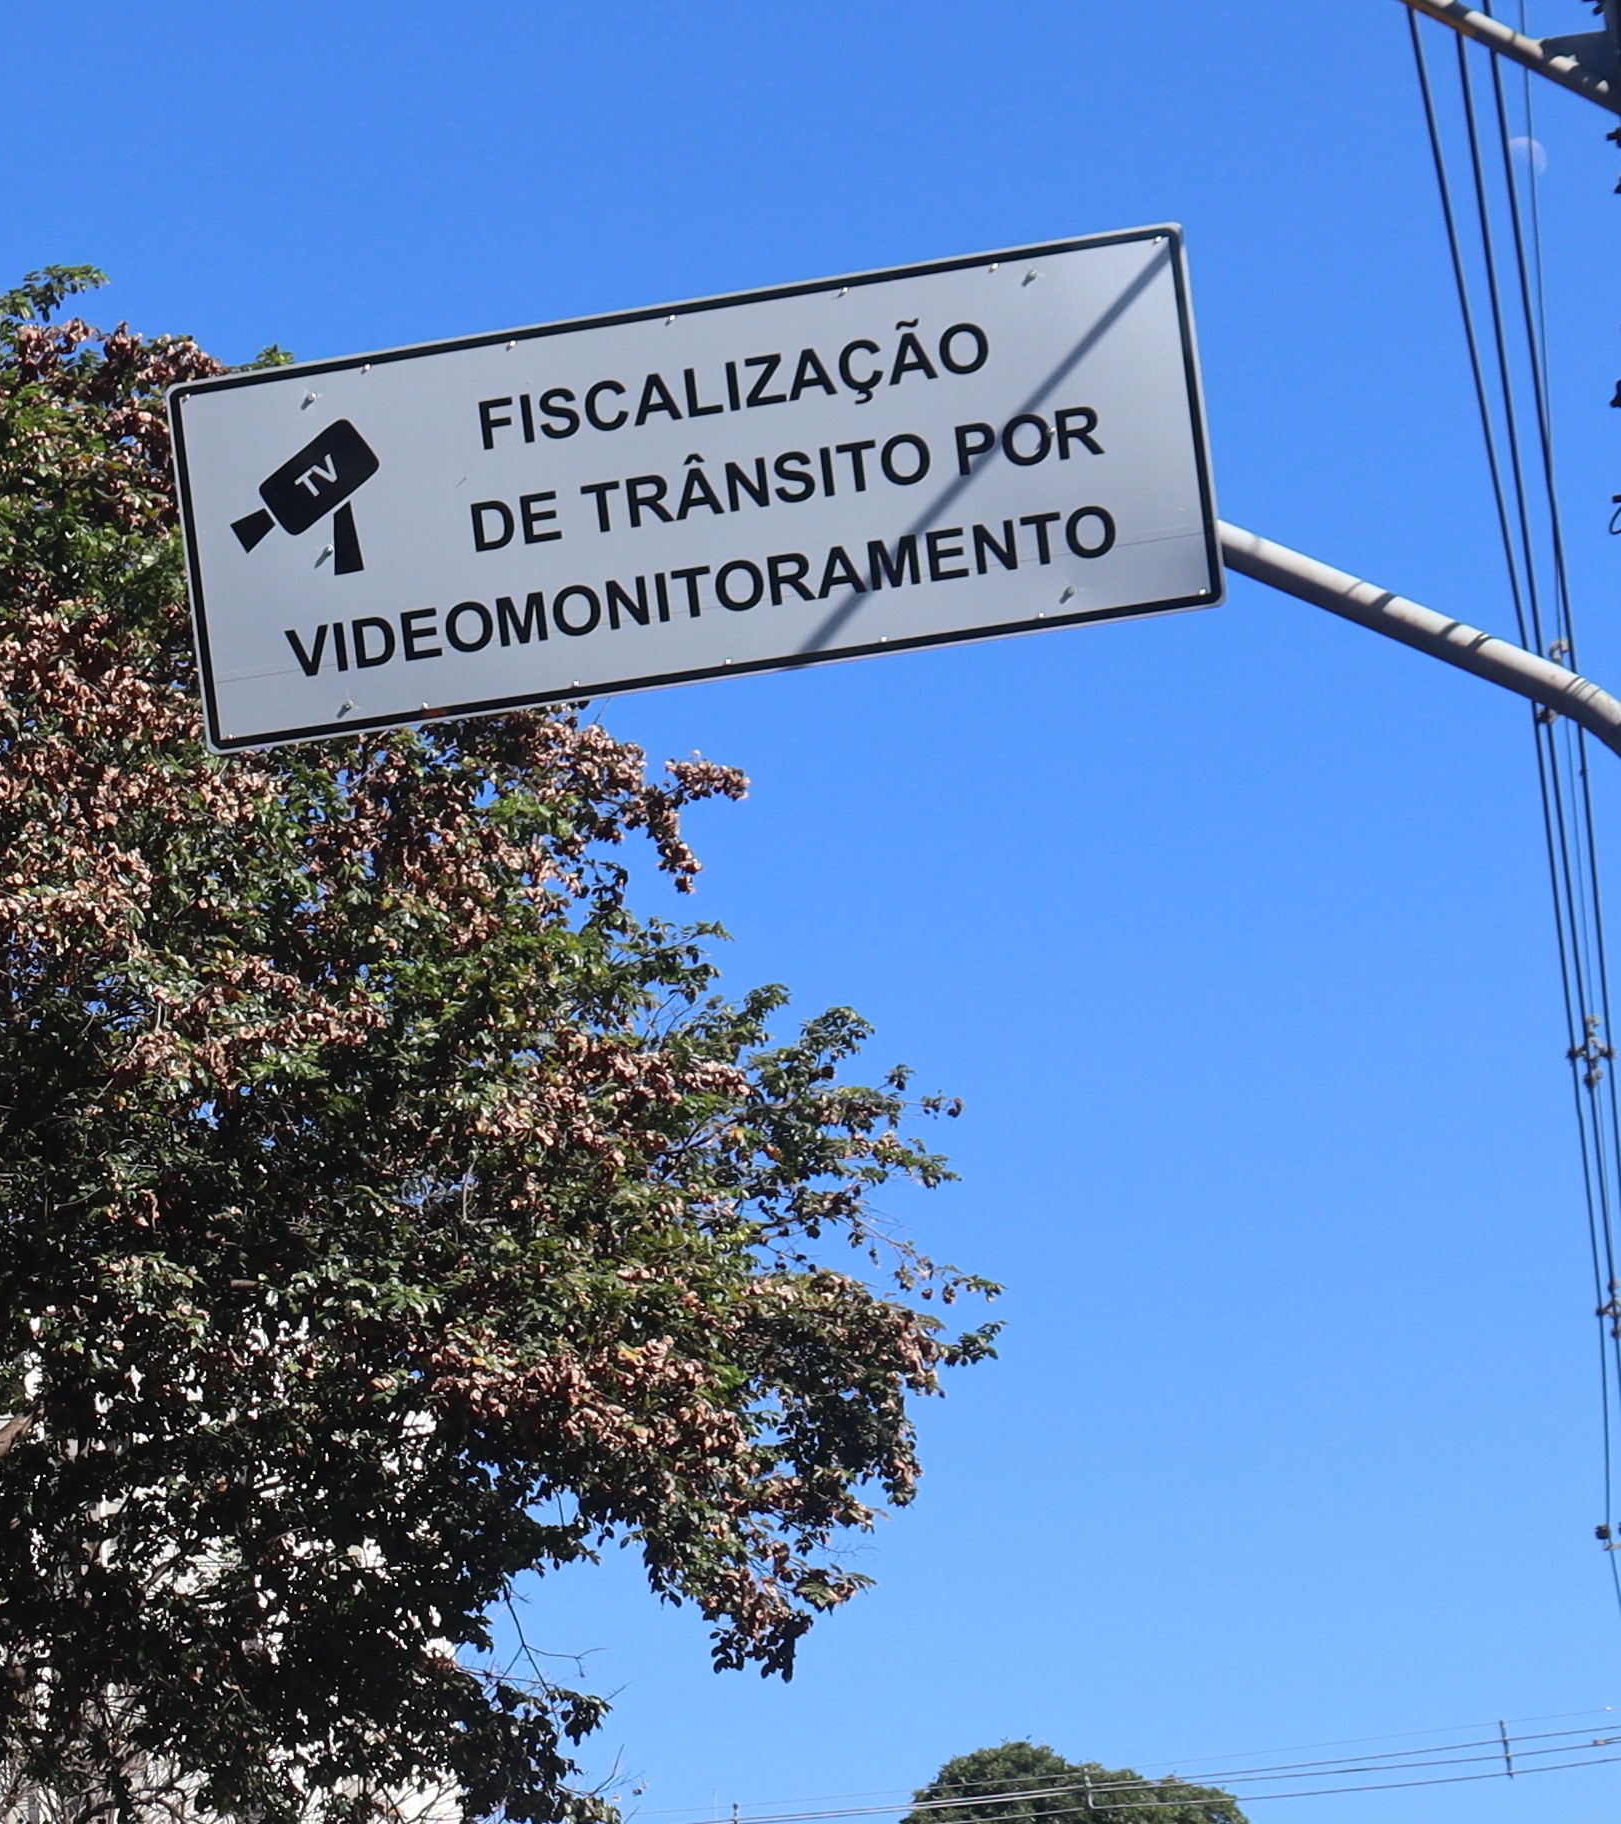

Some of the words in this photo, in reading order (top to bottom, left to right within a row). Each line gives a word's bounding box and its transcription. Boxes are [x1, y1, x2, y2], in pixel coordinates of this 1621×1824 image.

[478, 318, 990, 449] FISCALIZAÇÃO
[295, 452, 339, 499] TV
[470, 492, 563, 554] DE
[580, 433, 931, 534] TRÂNSITO
[954, 405, 1104, 478] POR
[285, 505, 1116, 677] VIDEOMONITORAMENTO
